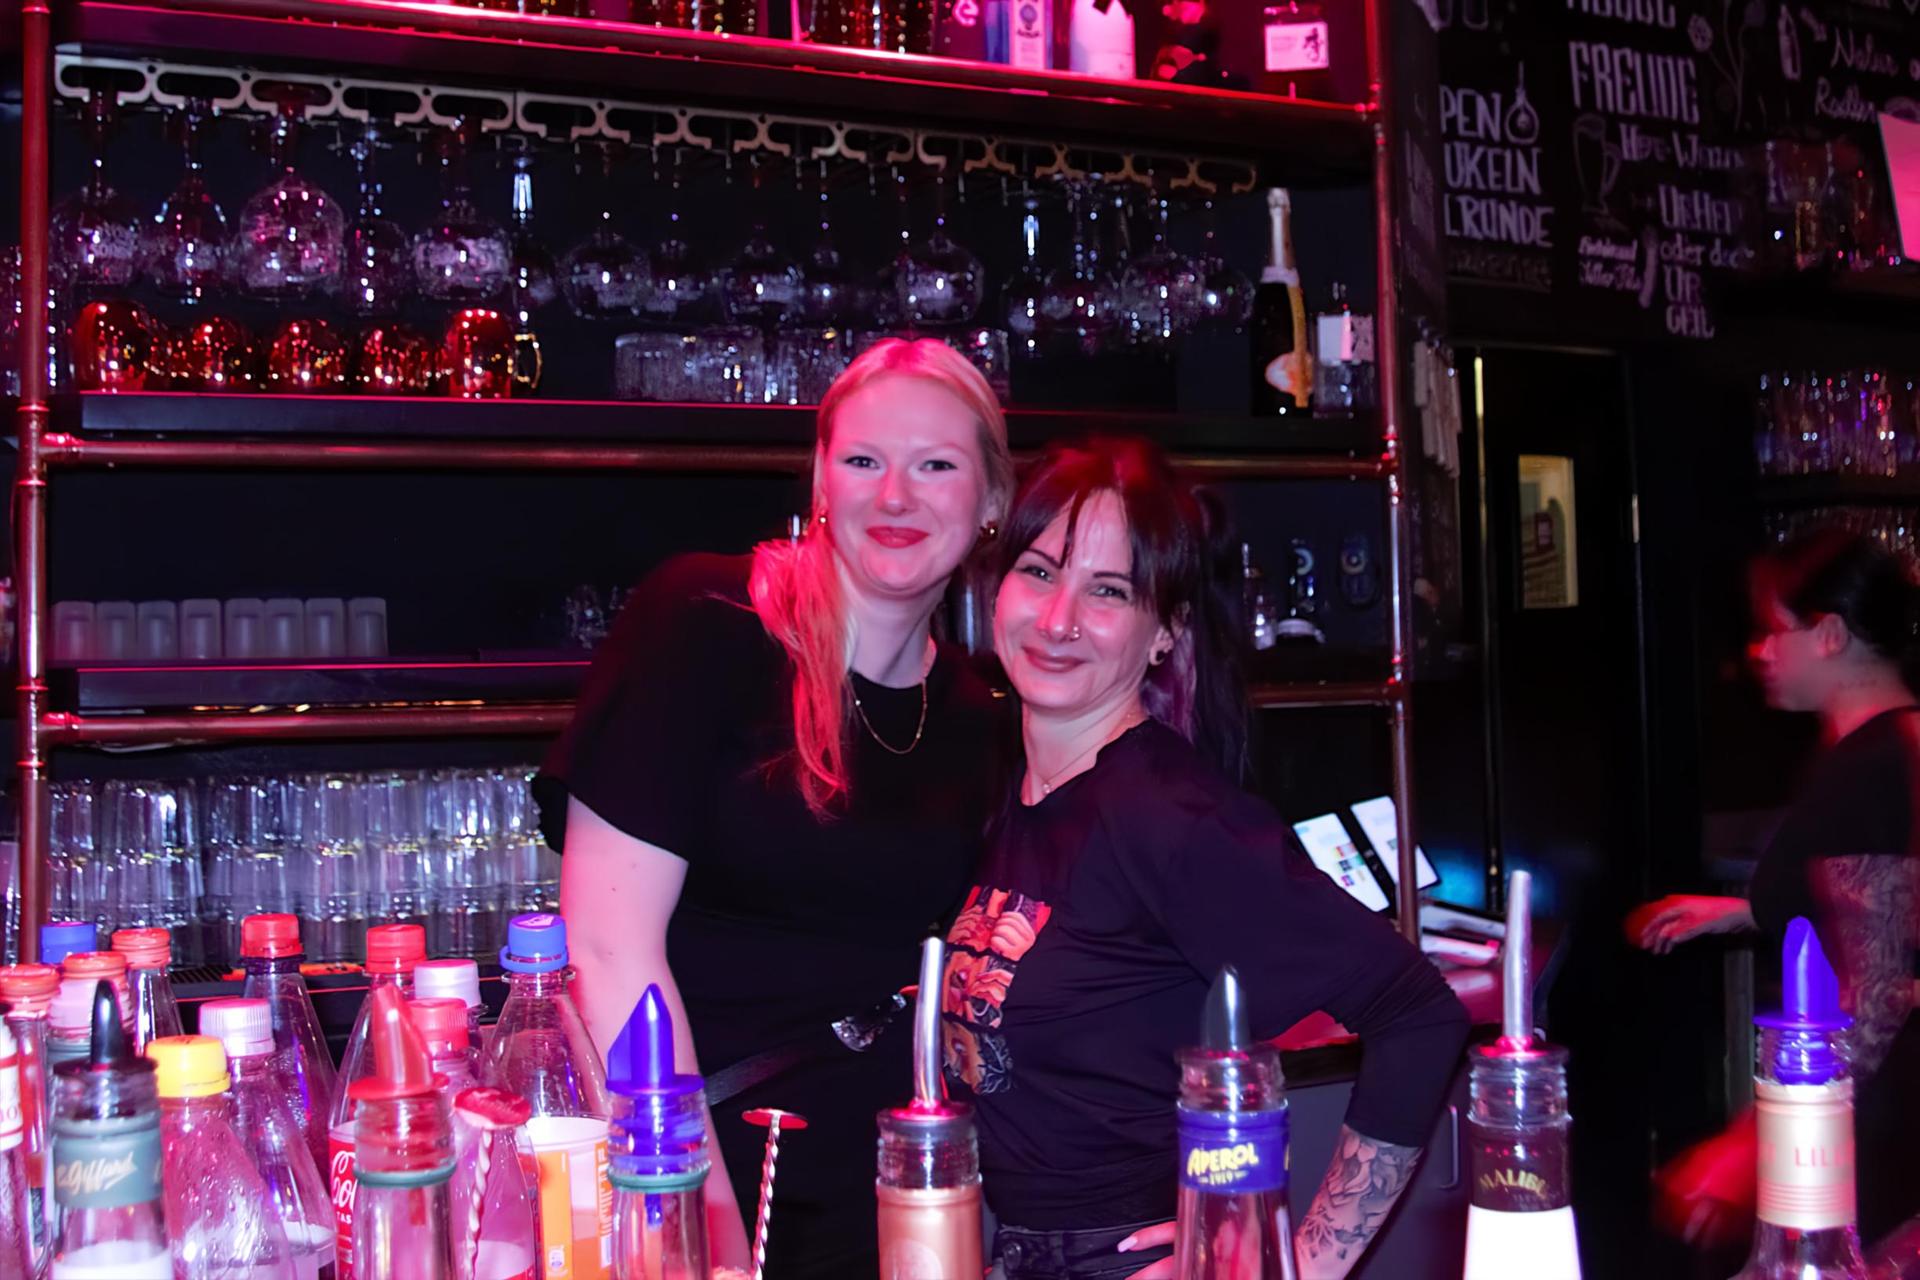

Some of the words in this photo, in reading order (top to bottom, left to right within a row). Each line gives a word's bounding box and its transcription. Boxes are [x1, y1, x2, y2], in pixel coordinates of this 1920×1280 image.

[1568, 40, 1701, 126] FREUDE
[1186, 1142, 1260, 1177] APEROL
[1478, 1168, 1548, 1201] MALIBU
